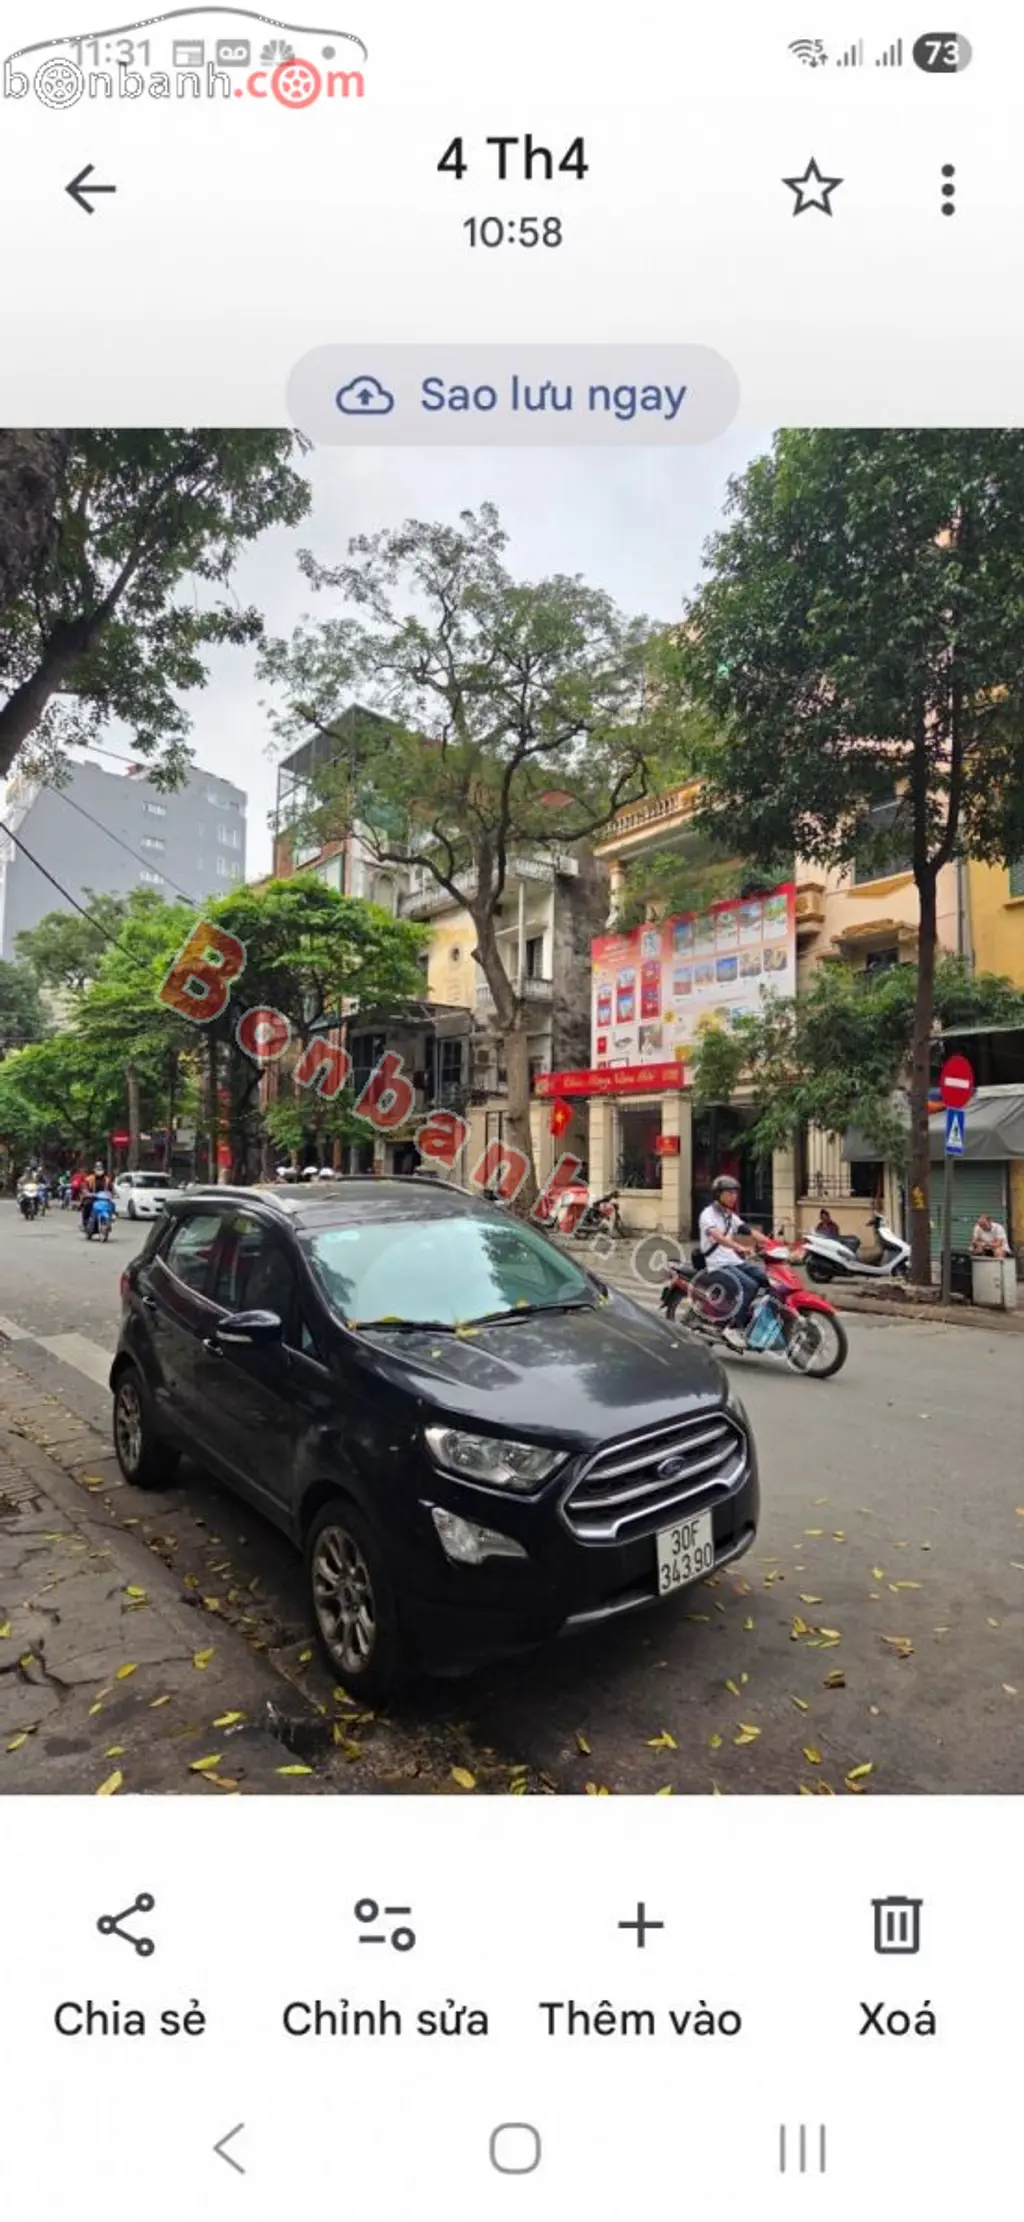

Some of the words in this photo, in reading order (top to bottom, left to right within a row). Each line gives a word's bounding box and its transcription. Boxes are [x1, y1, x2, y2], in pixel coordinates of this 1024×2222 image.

[70, 40, 151, 66] 11:31
[924, 41, 960, 65] 73
[437, 137, 467, 180] 4
[486, 134, 589, 180] Th4
[464, 216, 562, 249] 10:58
[421, 377, 497, 413] Sao
[512, 375, 573, 413] lưu
[588, 385, 687, 420] ngay
[671, 1520, 700, 1555] 30F
[53, 1999, 146, 2037] Chia
[159, 1997, 207, 2037] sẻ
[282, 1997, 402, 2037] Chỉnh
[416, 1997, 489, 2037] sửa
[538, 1999, 655, 2037] Thêm
[668, 1999, 742, 2037] vào
[858, 1999, 937, 2037] Xoá
